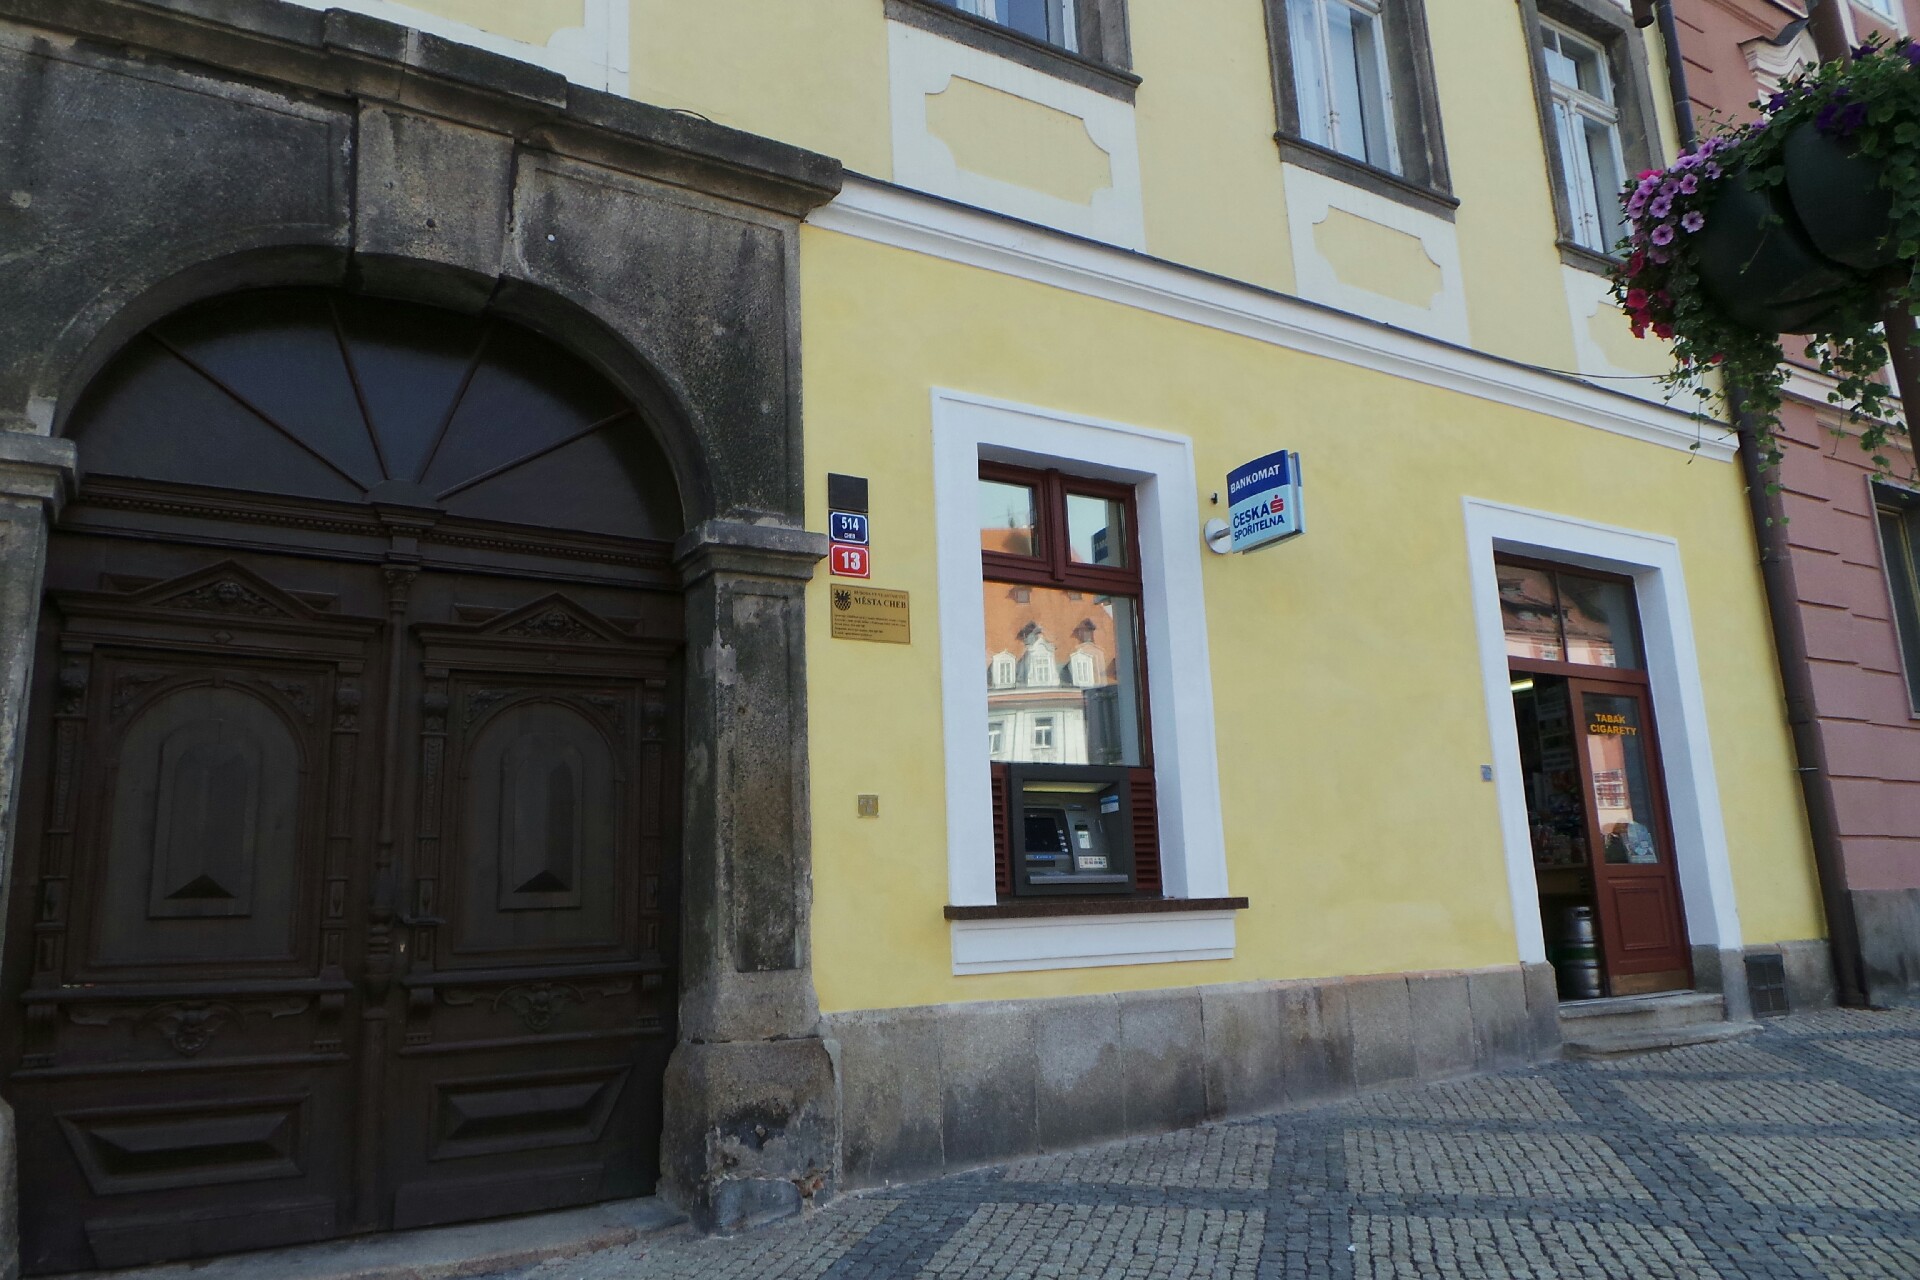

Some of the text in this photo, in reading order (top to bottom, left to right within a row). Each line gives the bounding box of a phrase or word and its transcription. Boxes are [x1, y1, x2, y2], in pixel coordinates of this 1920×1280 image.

[1230, 464, 1280, 494] BANKOMAT
[841, 516, 859, 531] 514
[1233, 500, 1270, 529] ČESKÁ
[1234, 514, 1285, 541] SPOŘITELNA
[841, 551, 861, 570] 13
[884, 599, 906, 608] CHEB
[1590, 724, 1637, 736] CIGARETY
